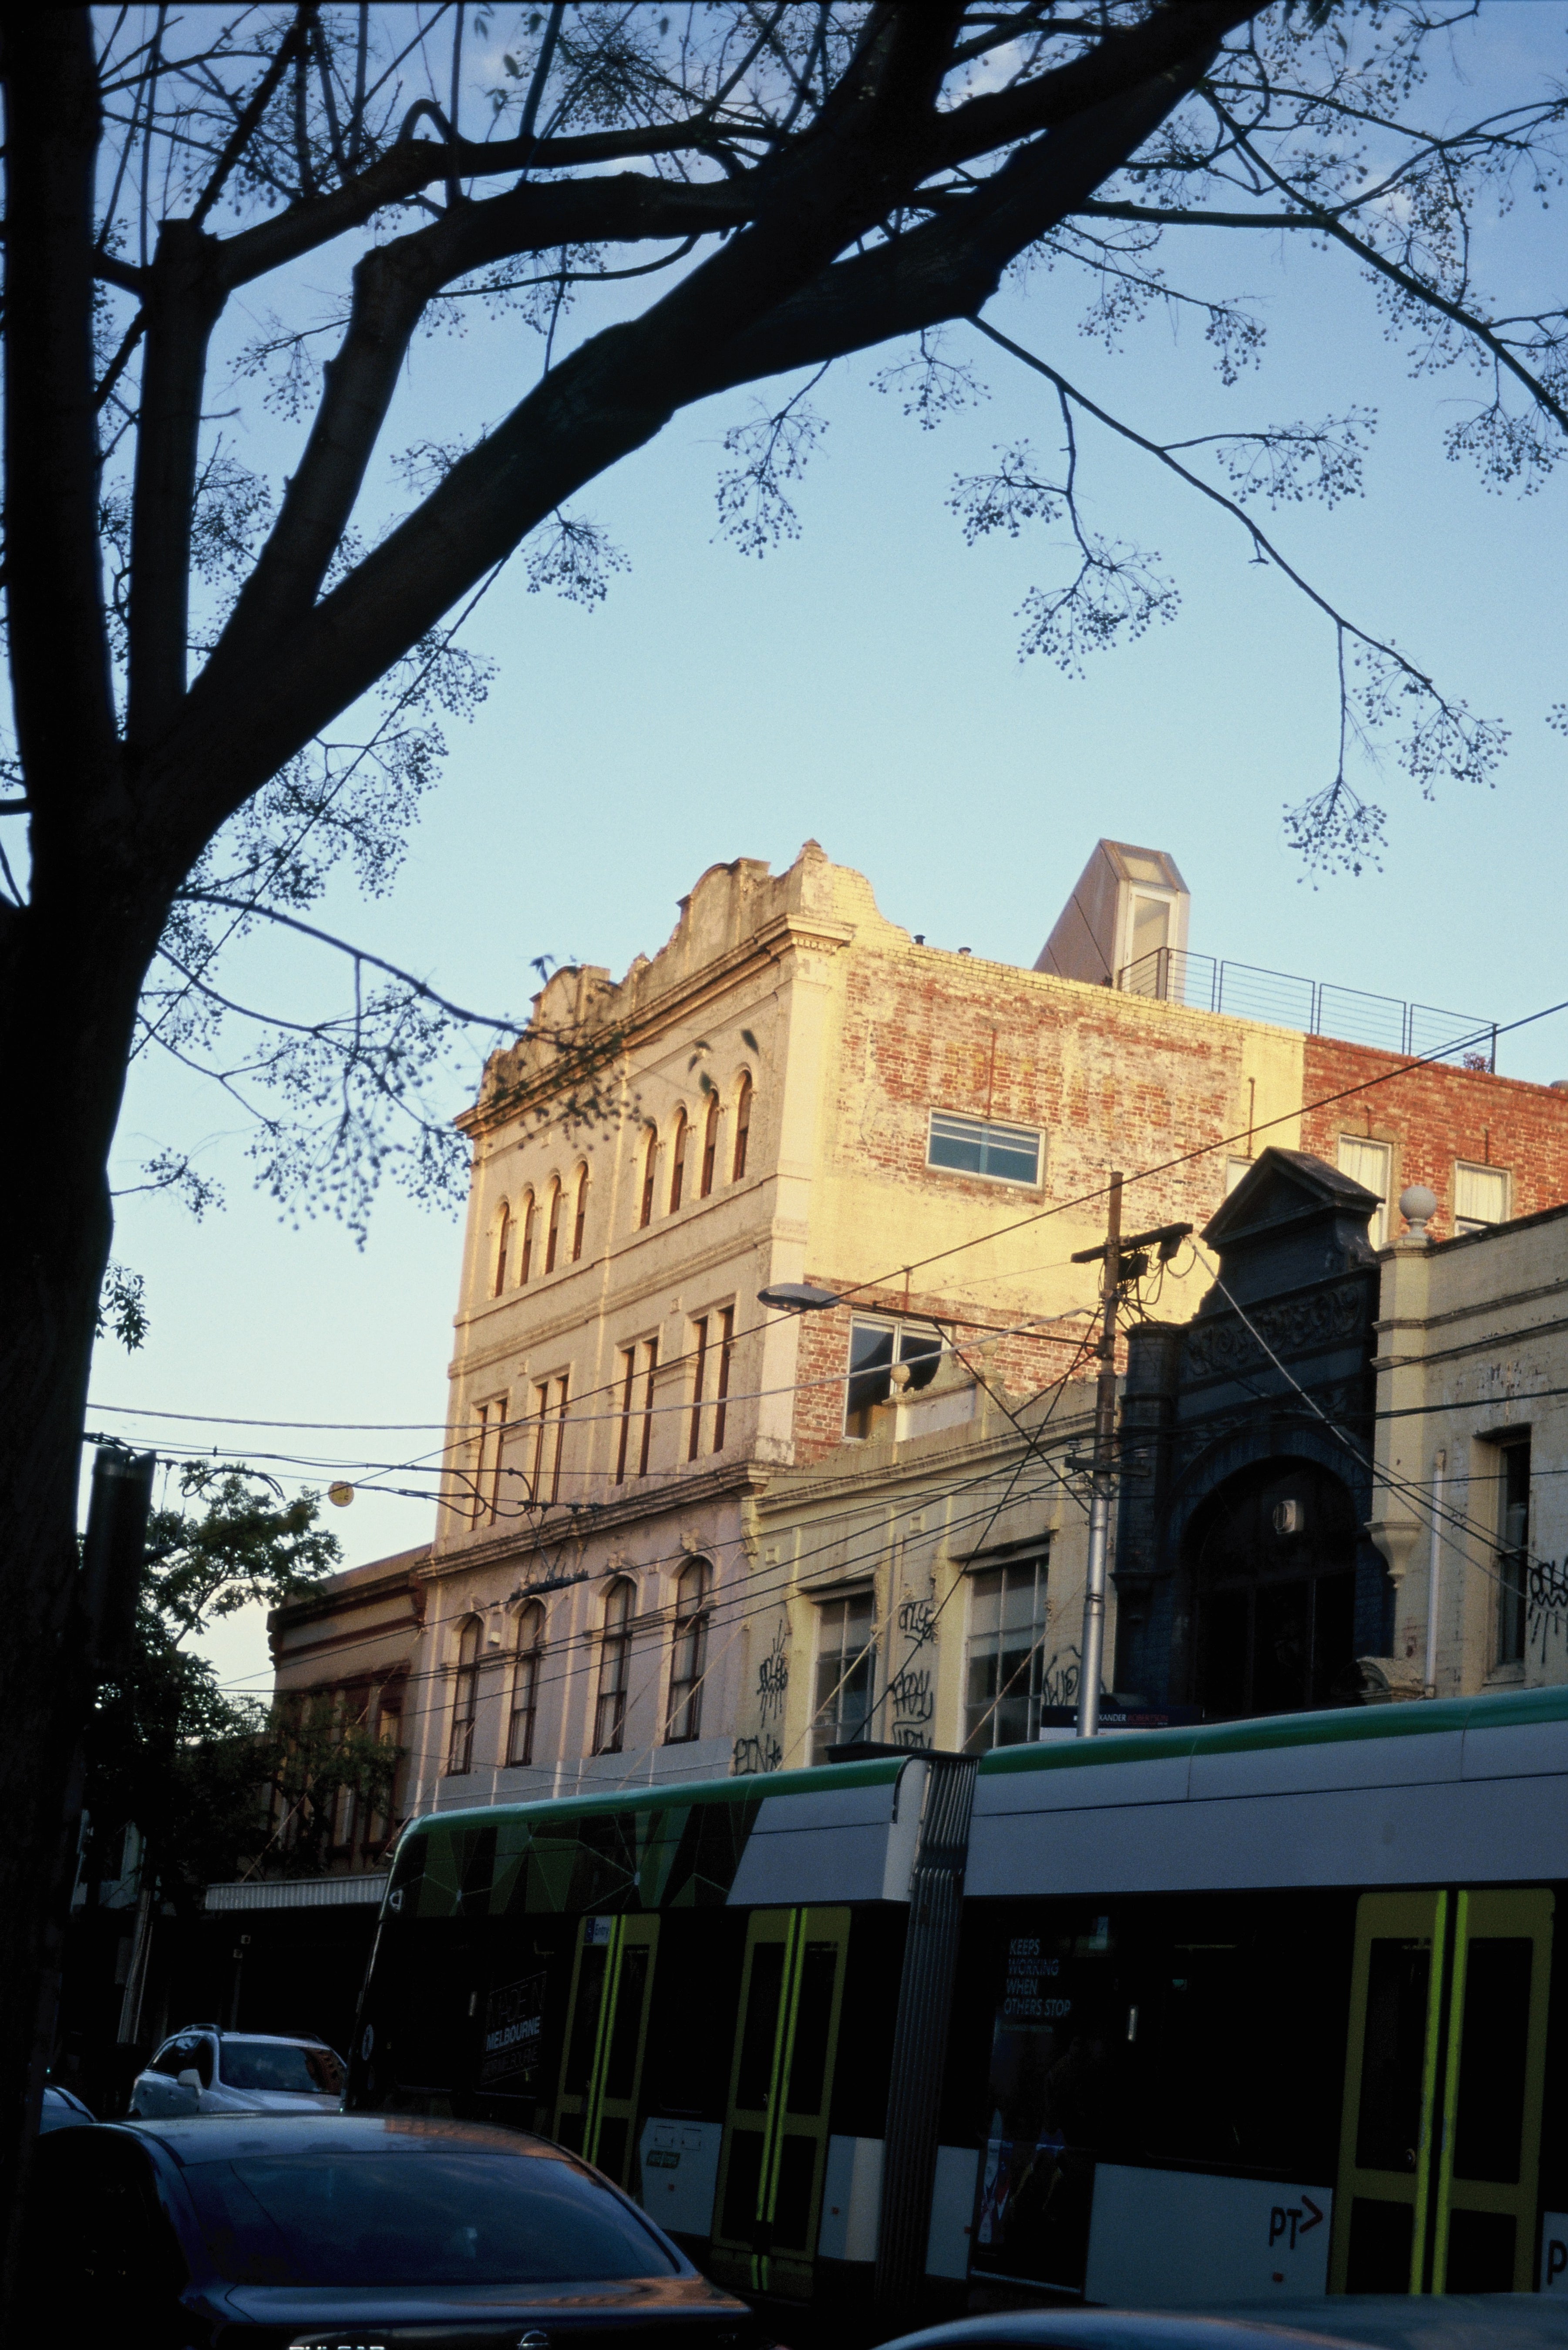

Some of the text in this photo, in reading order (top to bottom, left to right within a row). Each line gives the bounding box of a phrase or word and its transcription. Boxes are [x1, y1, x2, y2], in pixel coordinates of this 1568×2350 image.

[1009, 1938, 1040, 1955] KEEPS
[1008, 1958, 1059, 1976] WORKING
[1006, 1978, 1038, 1995] WHEN
[1004, 1997, 1071, 2017] OTHERS STOP
[486, 2016, 542, 2051] MELBOURNE
